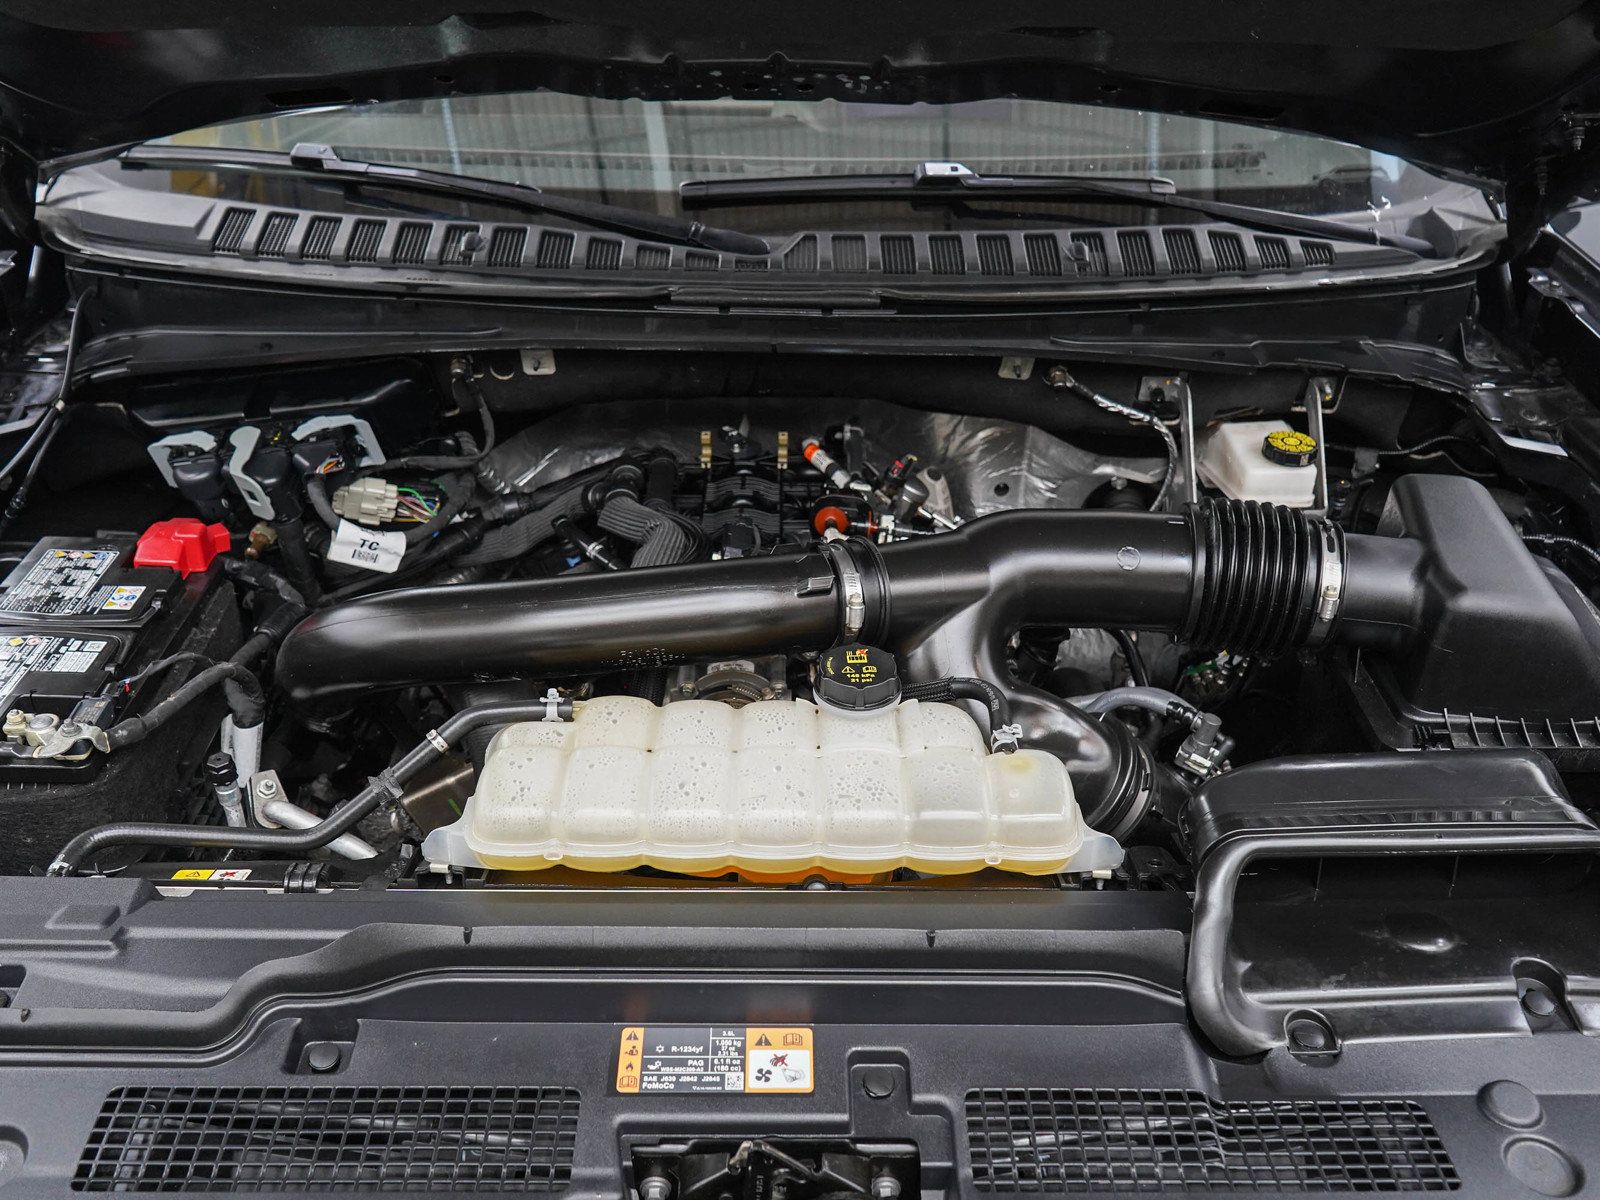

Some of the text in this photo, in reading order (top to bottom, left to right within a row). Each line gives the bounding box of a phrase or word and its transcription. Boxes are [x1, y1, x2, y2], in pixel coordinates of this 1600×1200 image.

[360, 538, 380, 551] TC
[733, 1039, 742, 1047] kg
[671, 1046, 703, 1054] R-1234yf
[642, 1081, 675, 1089] FoMoCo
